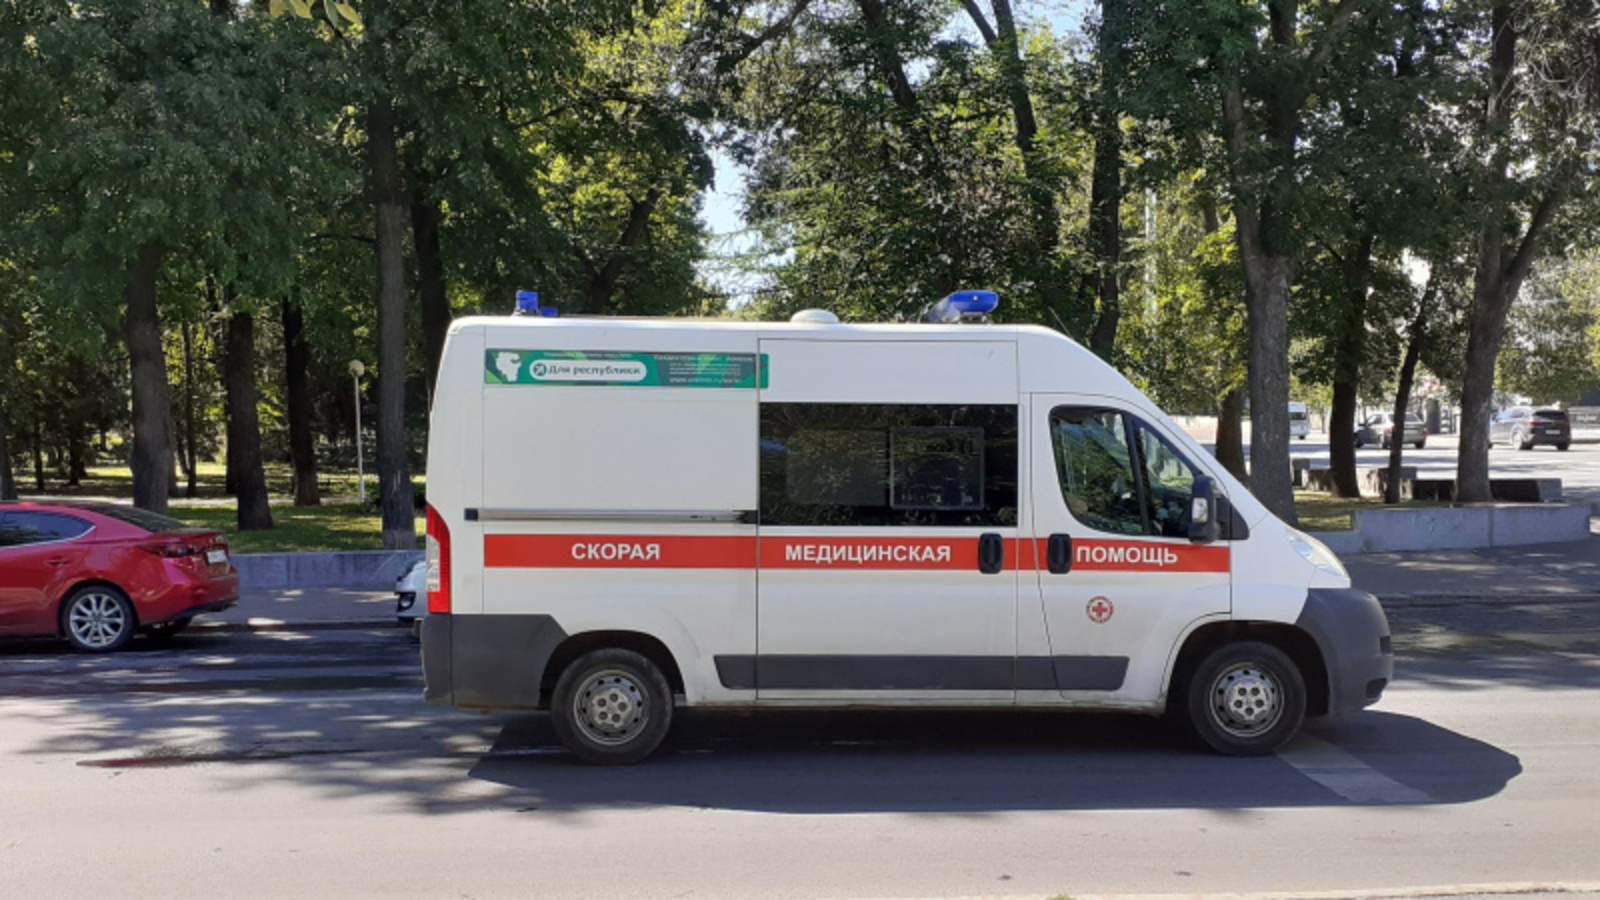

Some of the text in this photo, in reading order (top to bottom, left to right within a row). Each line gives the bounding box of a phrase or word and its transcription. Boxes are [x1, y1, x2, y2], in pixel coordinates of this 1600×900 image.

[548, 363, 641, 376] Для республики
[571, 543, 1178, 566] СКОРАЯ МЕДИЦИНСКАЯ ПОМОЩЬ
